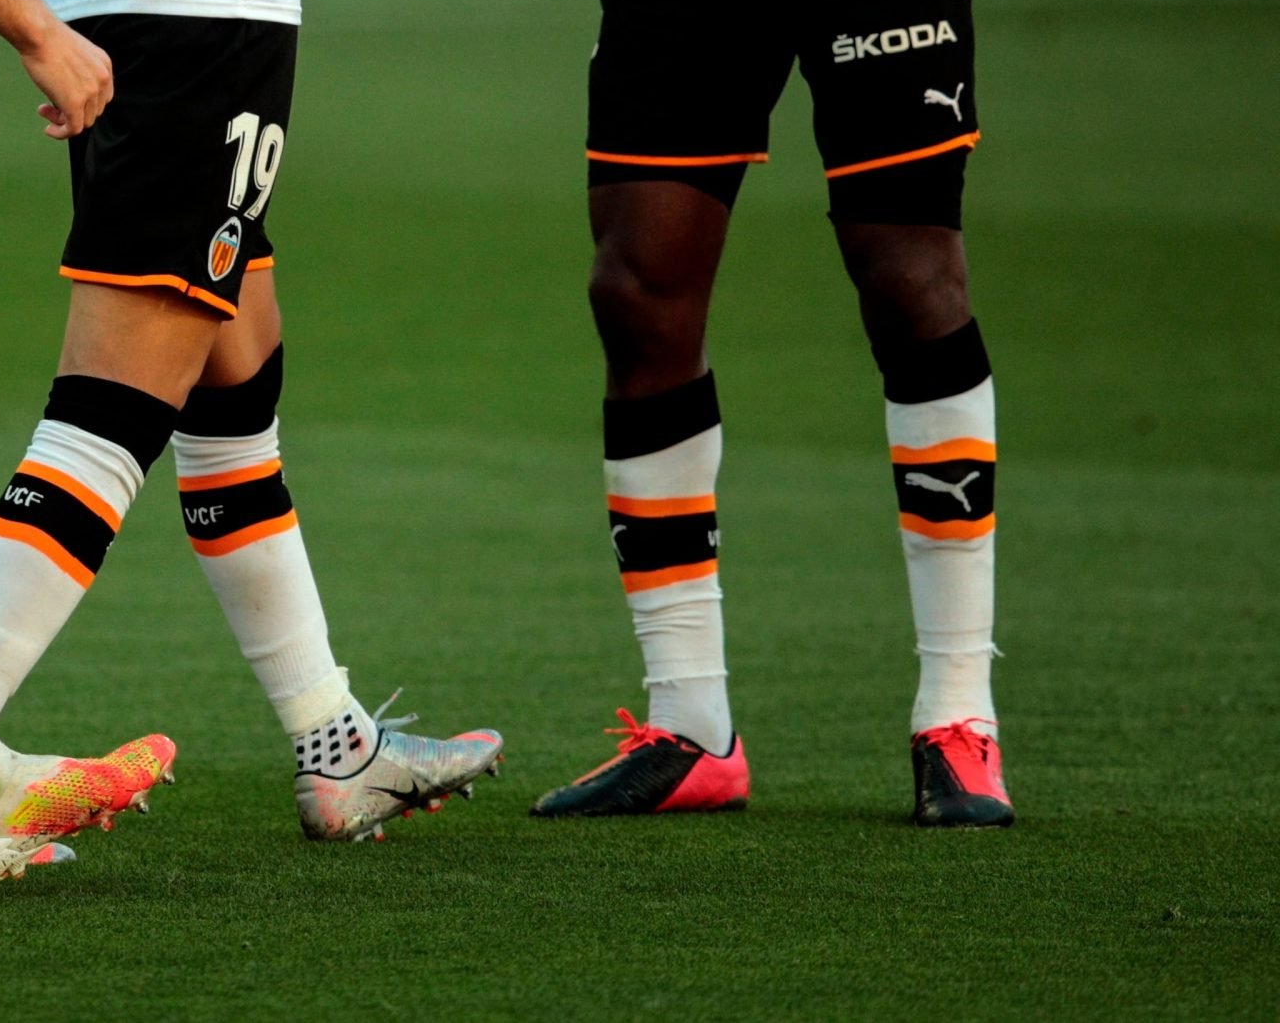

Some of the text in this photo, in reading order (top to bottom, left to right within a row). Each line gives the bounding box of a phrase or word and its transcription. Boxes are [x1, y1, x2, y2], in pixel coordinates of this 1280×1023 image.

[832, 20, 958, 64] ŠKODA
[225, 111, 285, 221] 19
[4, 484, 44, 507] VCF
[185, 505, 224, 526] VCF
